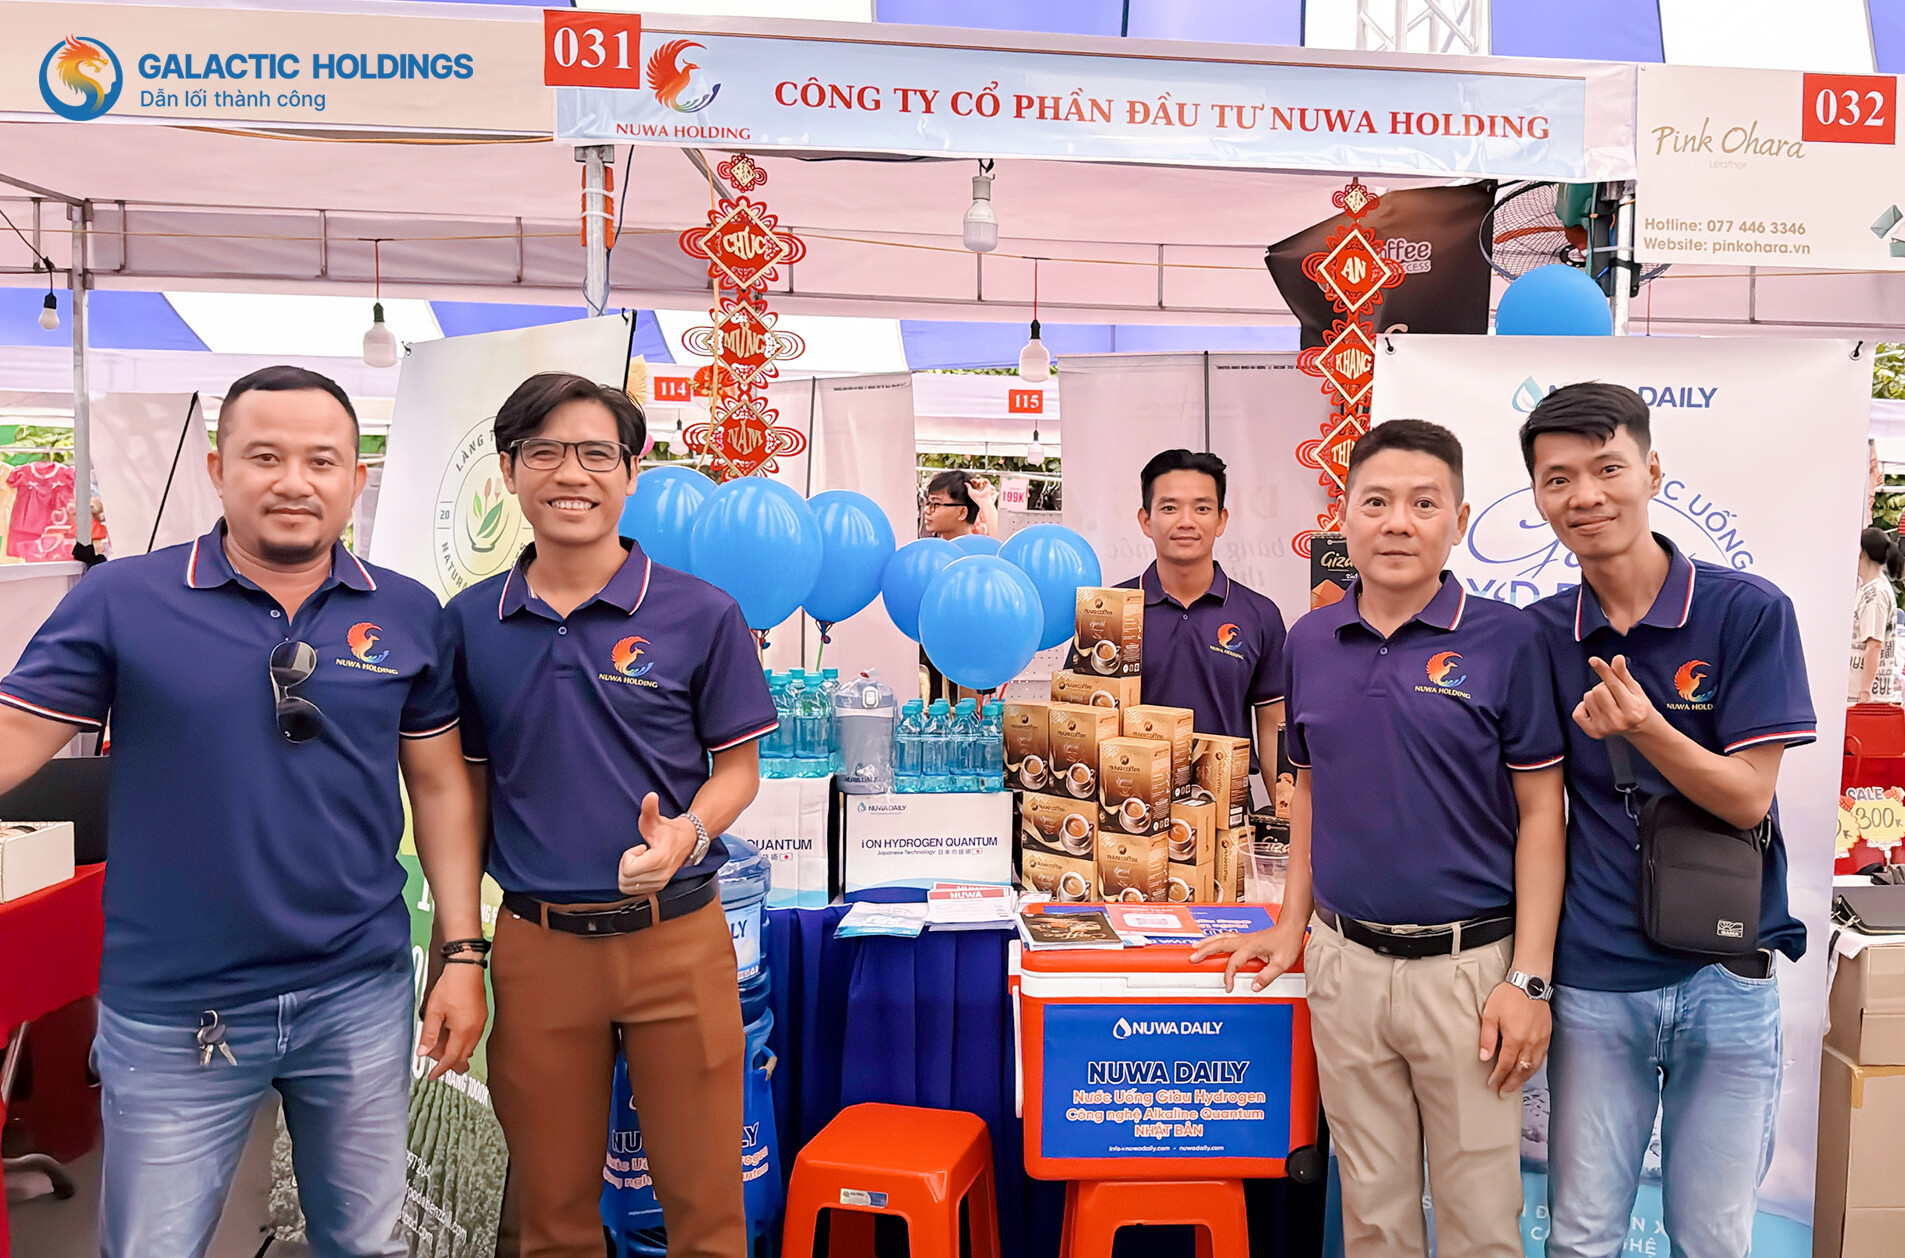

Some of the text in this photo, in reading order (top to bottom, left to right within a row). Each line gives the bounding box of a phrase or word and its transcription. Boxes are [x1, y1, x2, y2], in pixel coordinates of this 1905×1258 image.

[554, 27, 633, 69] 031
[774, 77, 1549, 140] CÔNG TY CỔ PHẦN ĐẦU TƯ NUWA HOLDING
[1815, 88, 1885, 127] 032
[616, 123, 750, 140] NUWA HOLDING
[1651, 117, 1805, 159] Pink Ohara
[1645, 218, 1806, 235] Hotline: 077 446 3346
[722, 225, 766, 260] CHÚC
[1643, 237, 1811, 254] Website: pinkohara.vn
[1340, 256, 1367, 285] AN
[1335, 348, 1372, 380] KHANG
[660, 380, 687, 397] 114
[1014, 393, 1040, 409] 115
[1003, 490, 1024, 503] 199K
[440, 509, 450, 520] 20
[1688, 493, 1754, 571] UỐNG
[335, 658, 399, 675] NUWA HOLDING
[598, 673, 659, 688] NUWA HOLDING
[1414, 685, 1471, 700] NUWA HOLDING
[1666, 702, 1690, 711] NUWA
[1847, 787, 1883, 801] SALE
[888, 804, 907, 812] DAILY
[884, 837, 943, 849] HYDROGEN
[945, 836, 998, 847] QUANTUM
[904, 848, 936, 856] Technology
[950, 890, 983, 899] NUWA
[1132, 1021, 1223, 1035] NUWA DAILY
[1087, 1060, 1250, 1084] NUWA DAILY
[1073, 1088, 1266, 1107] Nước Uống Giàu Hydrogen
[1066, 1107, 1265, 1124] Công nghệ Alkaline Quantum
[1134, 1122, 1204, 1140] NHẬT BẢN
